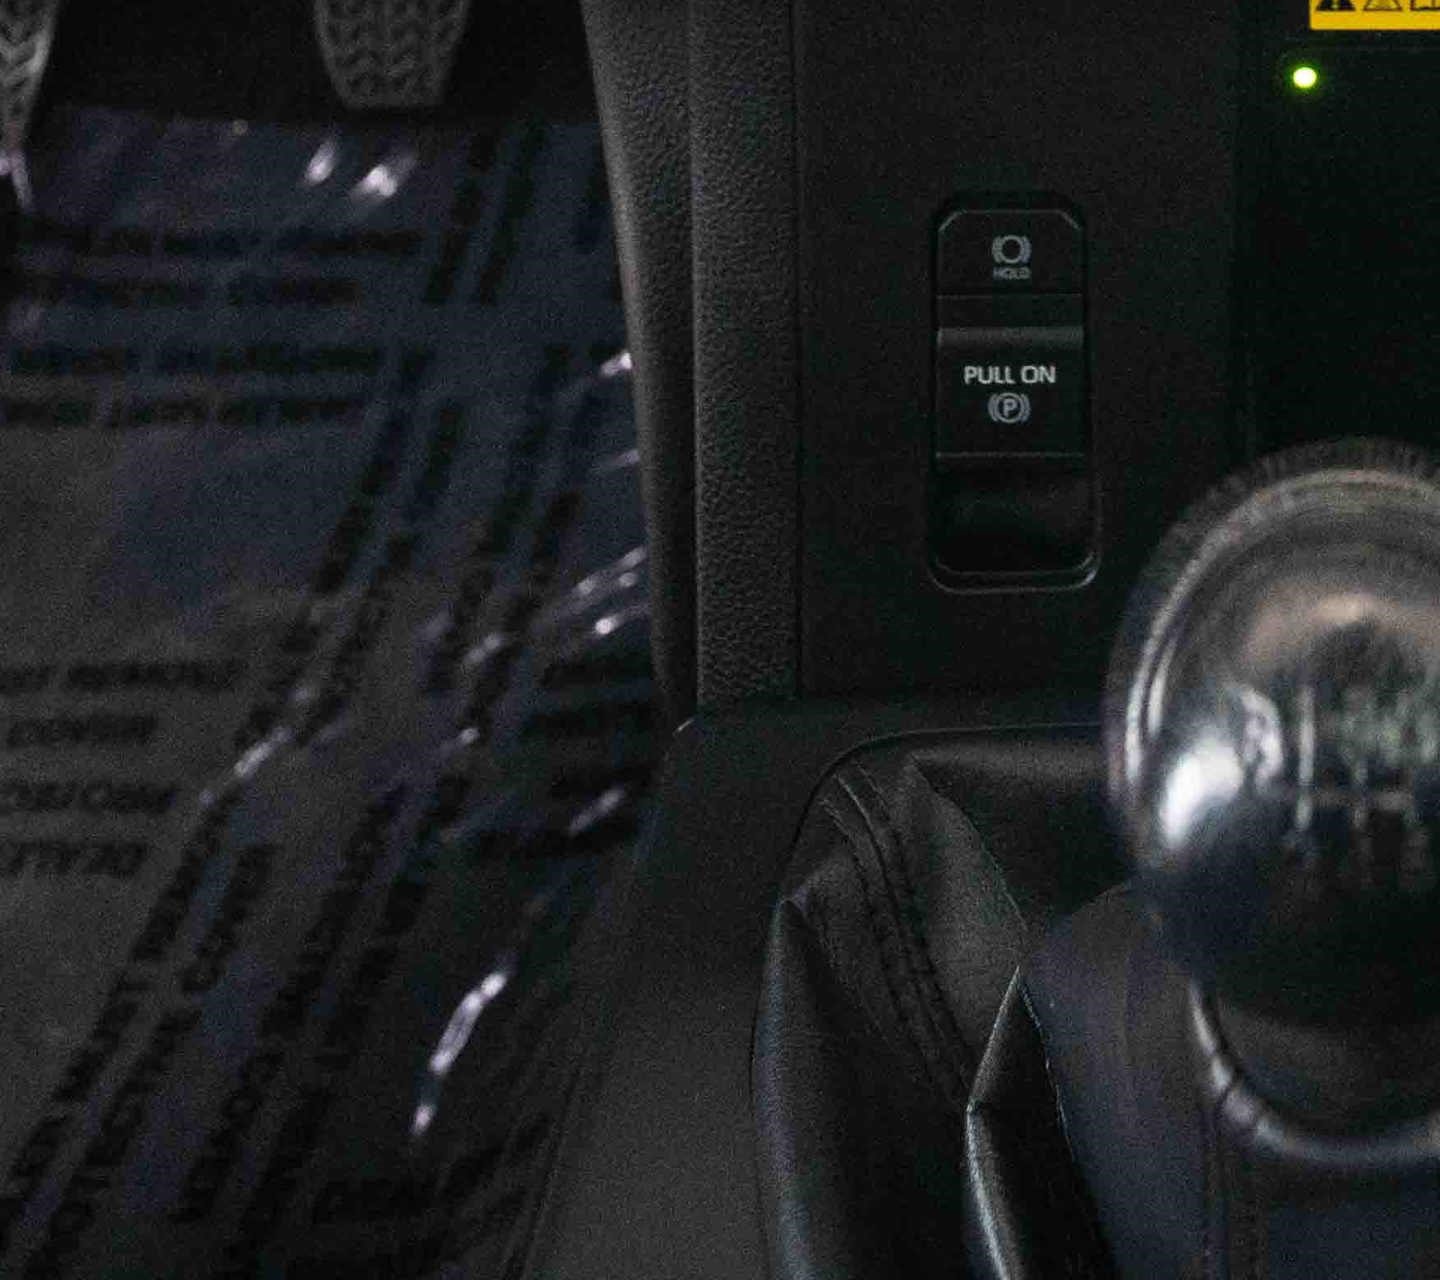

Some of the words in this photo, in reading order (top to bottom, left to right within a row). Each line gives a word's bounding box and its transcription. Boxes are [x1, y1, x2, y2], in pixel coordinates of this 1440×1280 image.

[992, 268, 1033, 280] HOLD
[964, 365, 1015, 384] PULL
[1021, 366, 1057, 384] ON
